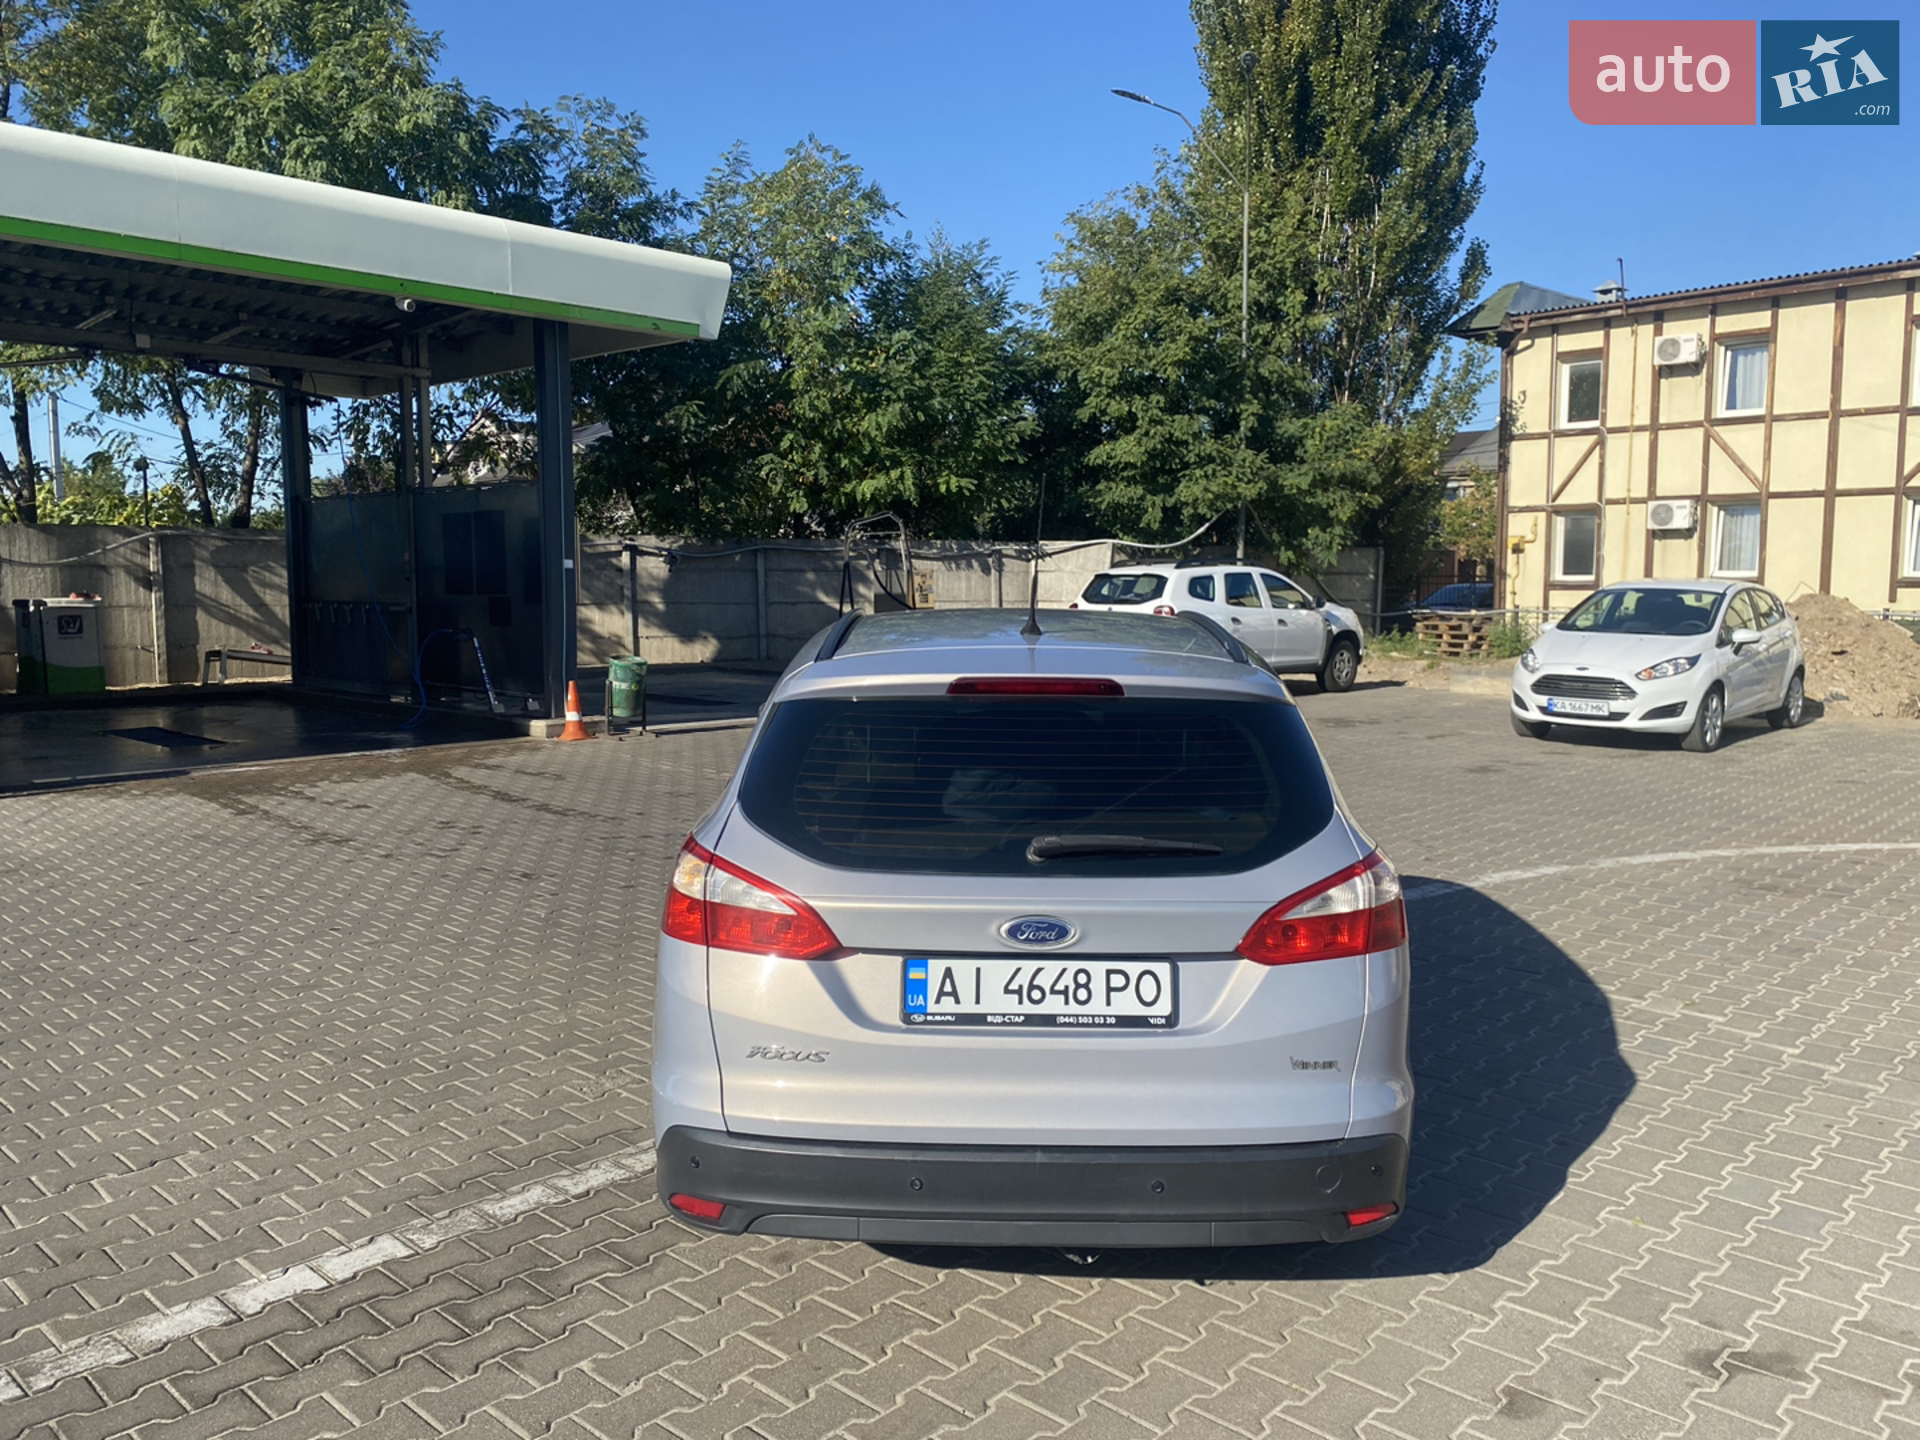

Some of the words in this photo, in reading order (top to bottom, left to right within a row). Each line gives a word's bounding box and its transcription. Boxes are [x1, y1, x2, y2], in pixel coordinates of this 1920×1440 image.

[1016, 922, 1059, 940] Ford
[934, 967, 981, 1005] AI
[1003, 967, 1093, 1006] 4648
[1105, 969, 1162, 1007] PO
[908, 994, 925, 1006] UA
[1056, 1016, 1077, 1025] (044)
[1078, 1016, 1092, 1024] 503
[1094, 1016, 1104, 1024] 03
